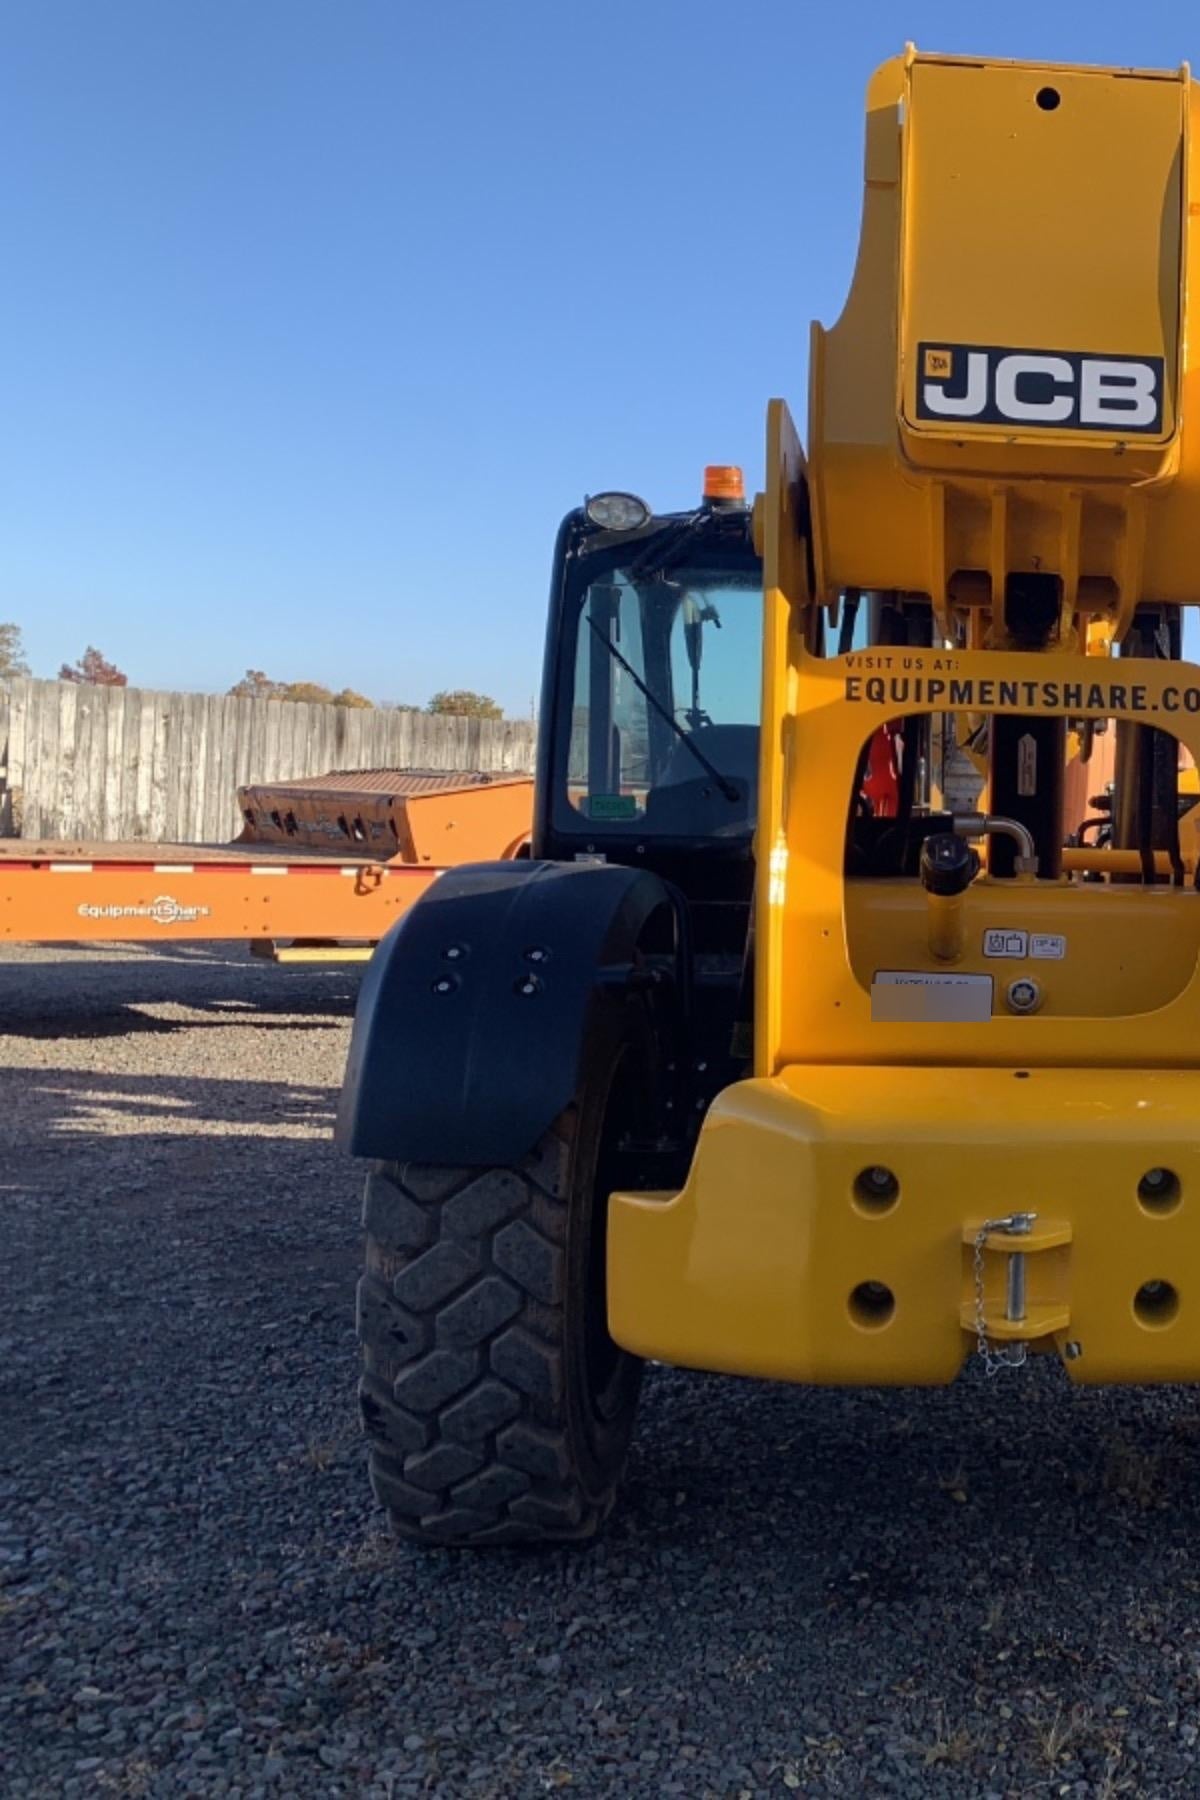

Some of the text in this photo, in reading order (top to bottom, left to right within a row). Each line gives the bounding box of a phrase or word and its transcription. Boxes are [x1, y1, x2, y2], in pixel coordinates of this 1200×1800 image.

[923, 352, 1158, 426] JCB
[845, 656, 960, 671] VISIT US AT:
